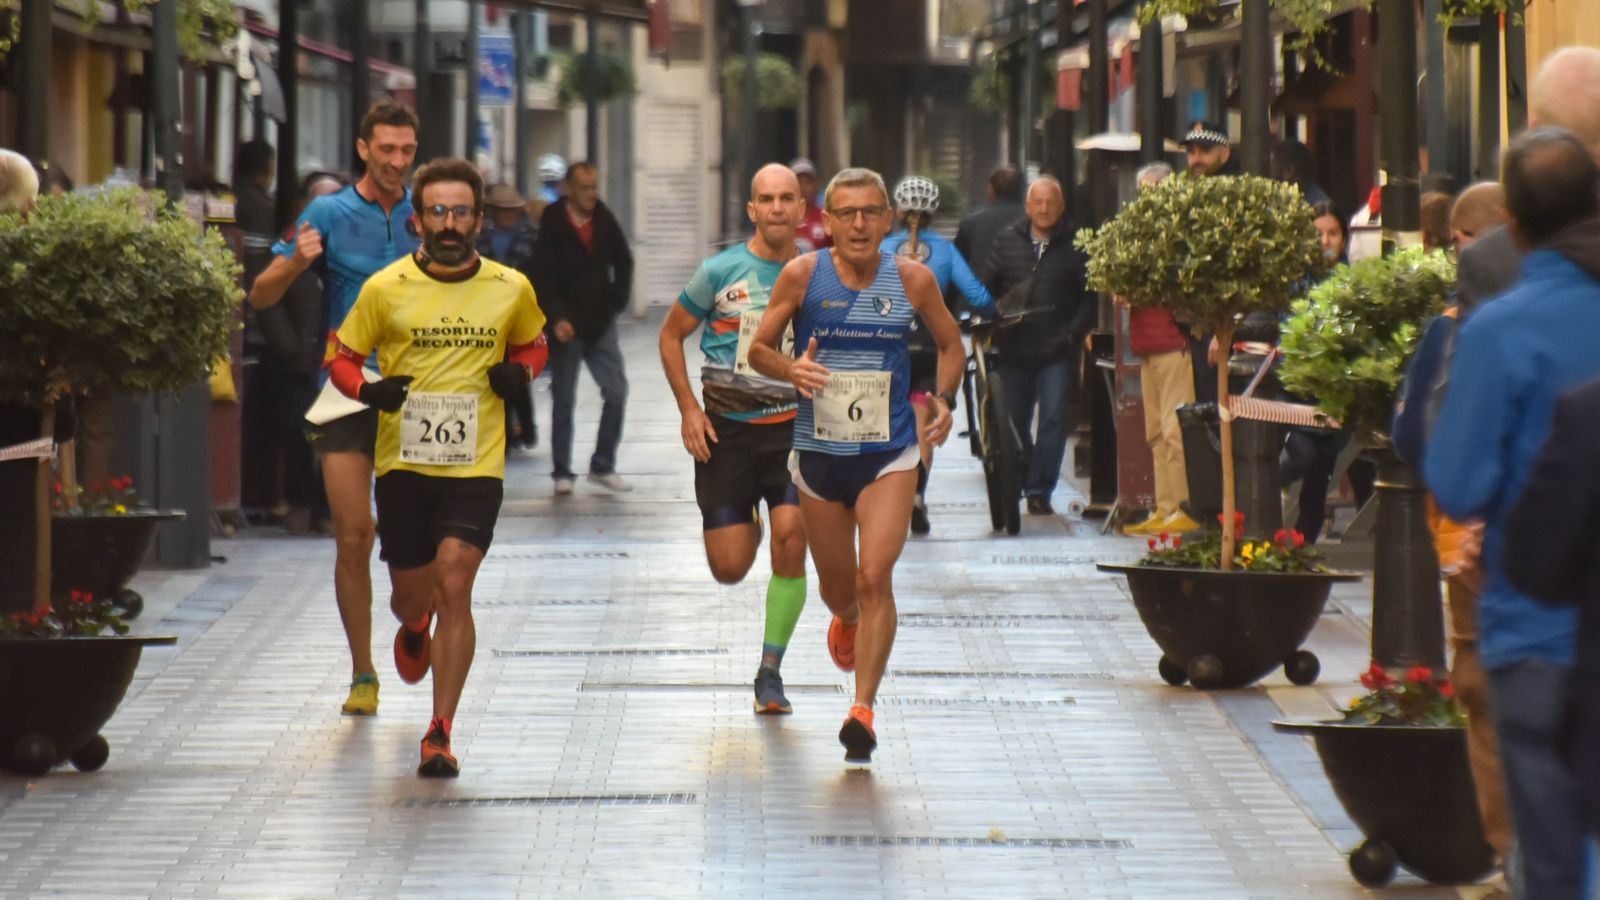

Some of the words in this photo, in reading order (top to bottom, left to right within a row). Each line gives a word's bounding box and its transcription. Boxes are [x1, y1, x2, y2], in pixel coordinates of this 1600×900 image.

[410, 327, 498, 337] TESORILLO
[812, 327, 829, 337] Club
[830, 328, 874, 338] Atletismo
[412, 338, 495, 348] SECADERO
[847, 394, 863, 422] 6
[419, 418, 466, 445] 263
